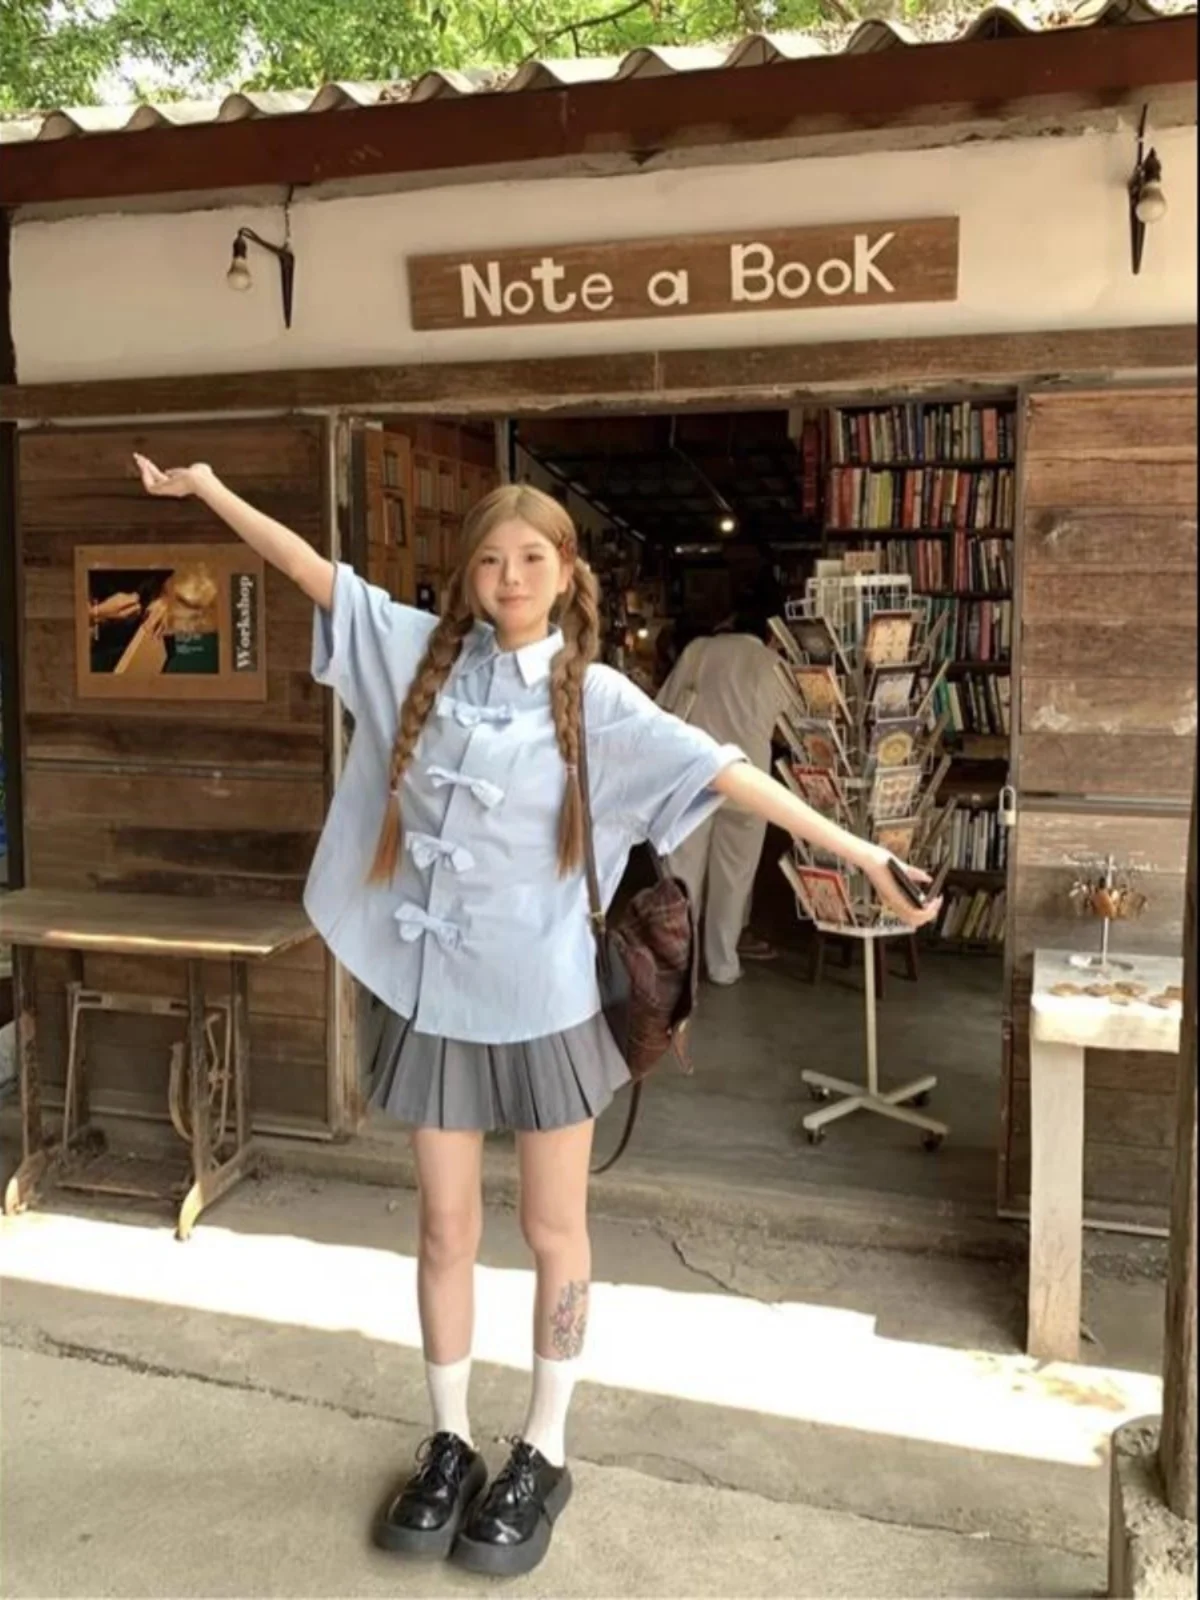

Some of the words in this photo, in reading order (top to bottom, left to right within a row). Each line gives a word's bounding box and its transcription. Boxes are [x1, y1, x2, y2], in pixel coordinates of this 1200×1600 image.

[460, 257, 614, 319] Note
[647, 270, 689, 306] a
[235, 575, 255, 669] Workshop
